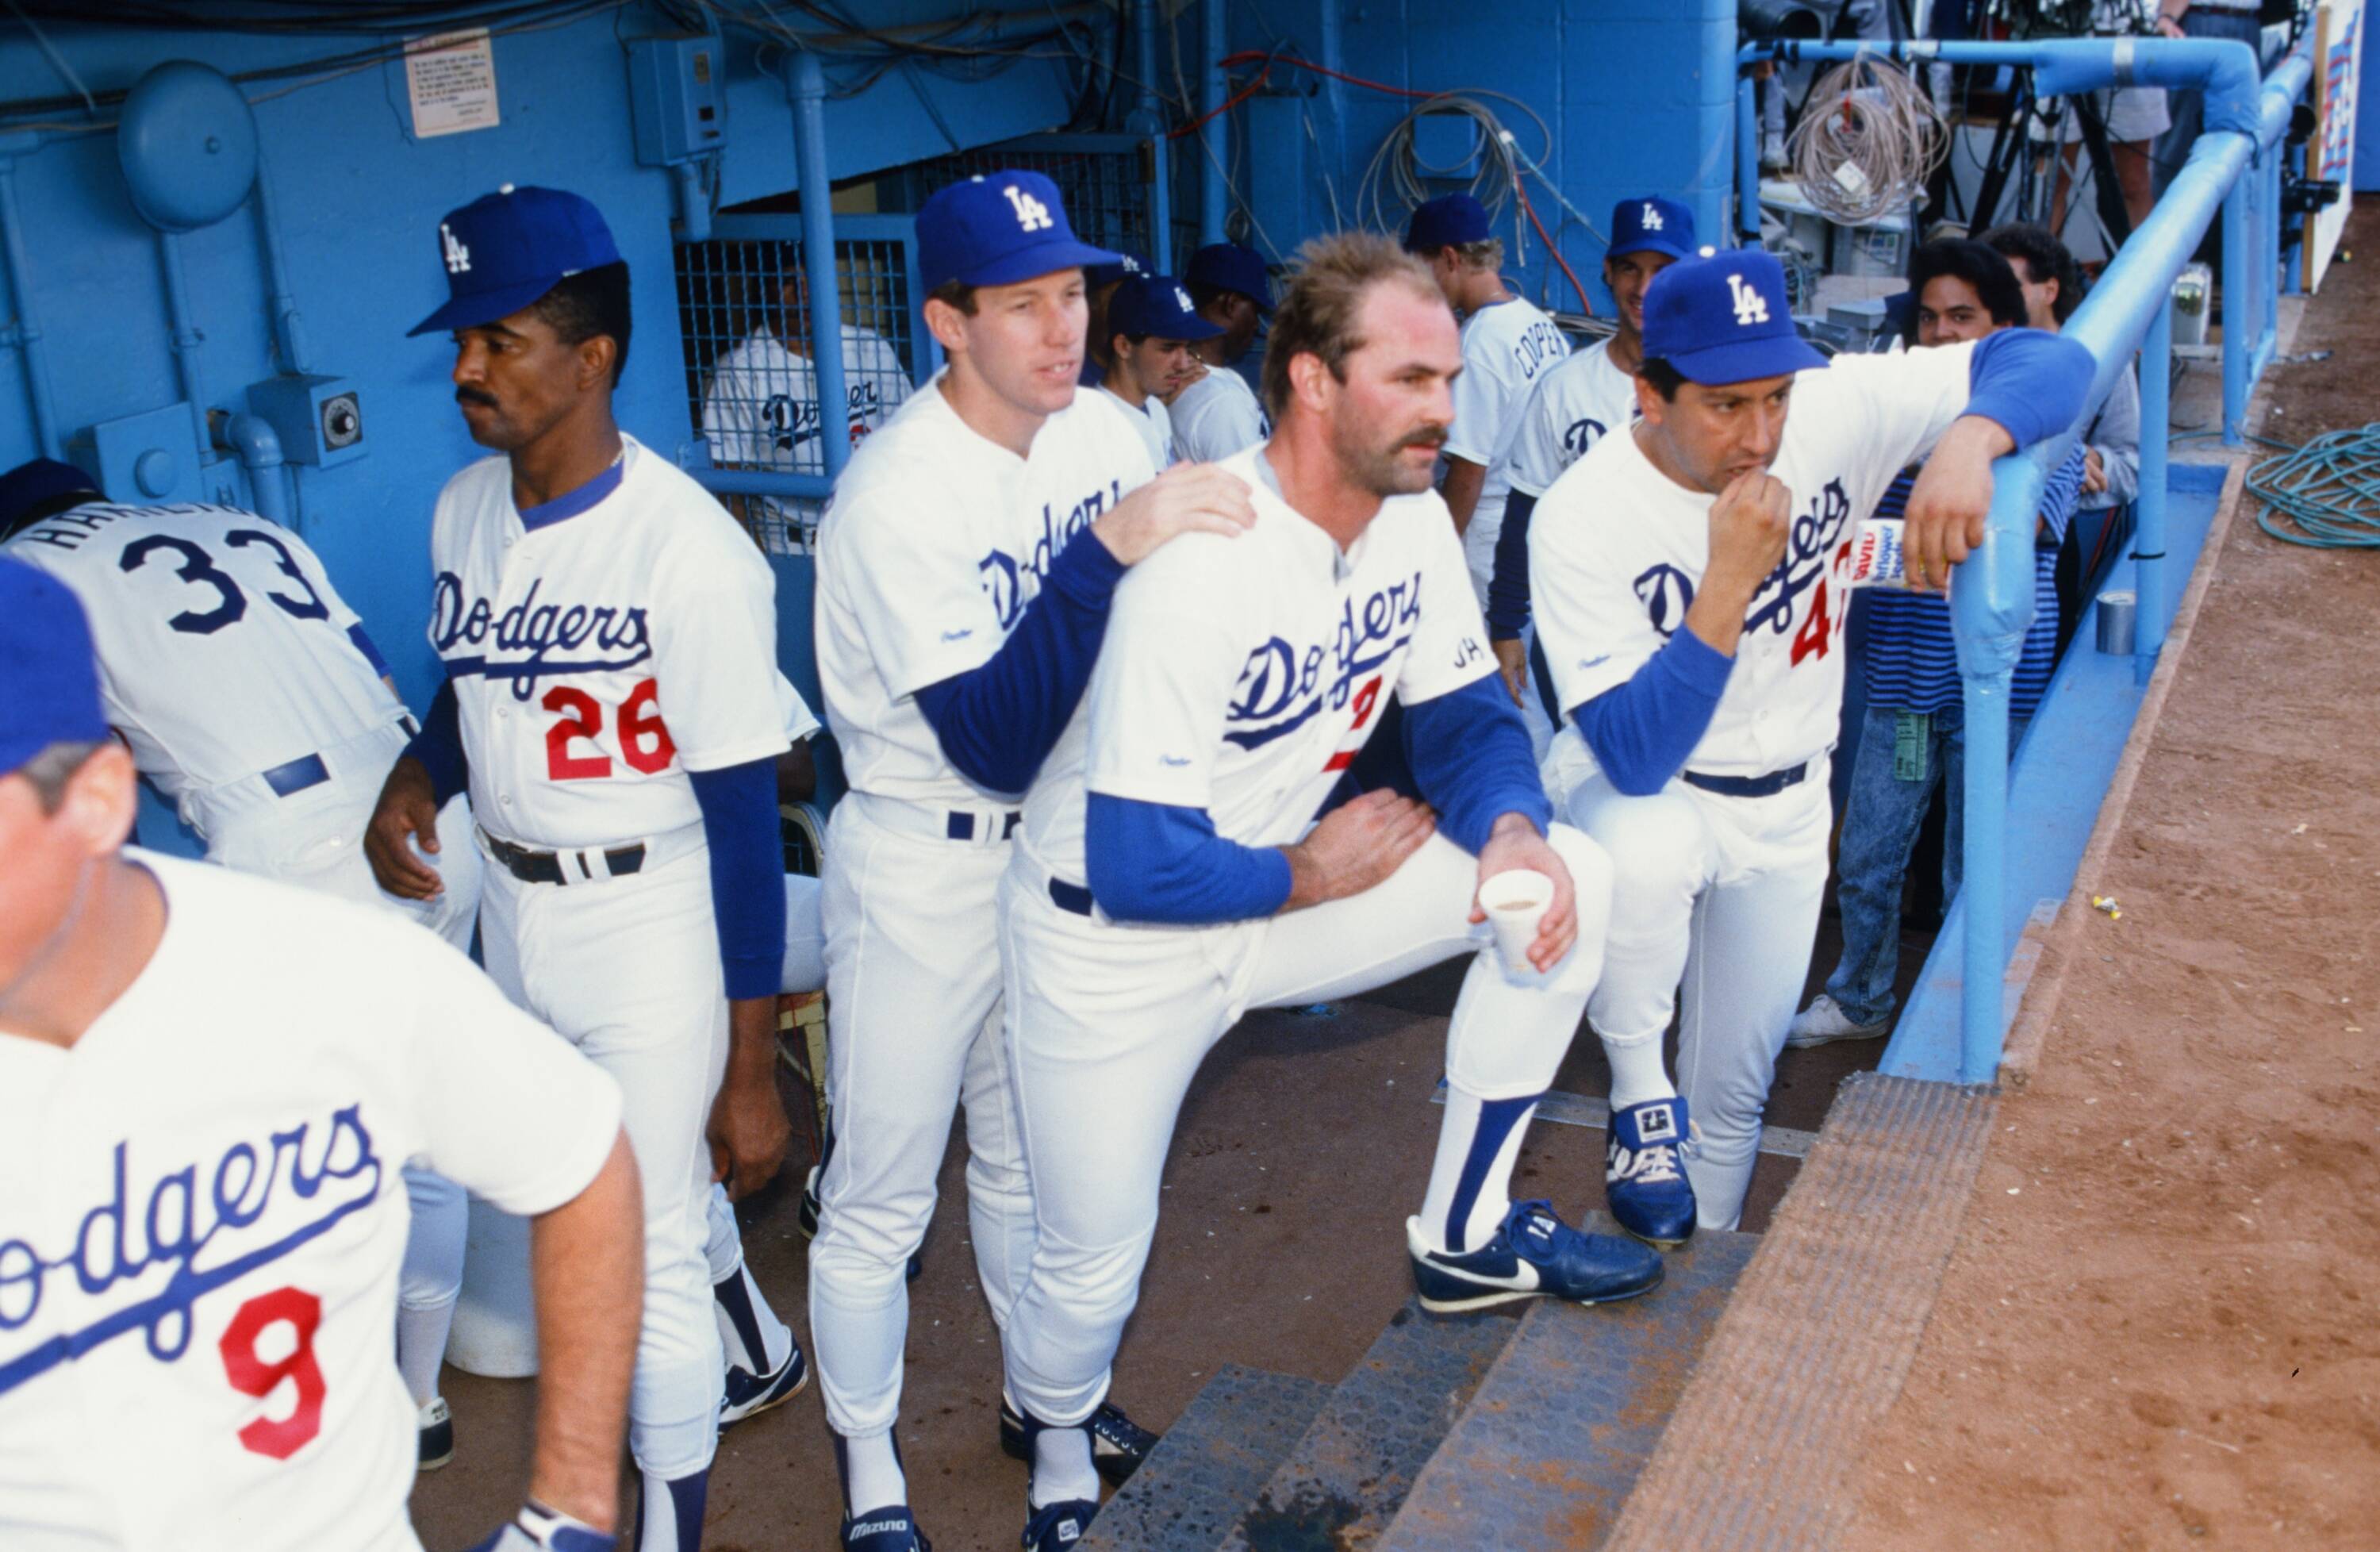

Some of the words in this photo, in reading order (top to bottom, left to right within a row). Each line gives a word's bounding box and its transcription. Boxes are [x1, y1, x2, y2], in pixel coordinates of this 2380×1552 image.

[440, 224, 472, 274] LA
[1003, 185, 1054, 232] LA
[1641, 203, 1664, 231] LA
[1726, 274, 1770, 325] LA
[119, 533, 330, 636] 33
[433, 570, 653, 702] Dodgers
[541, 677, 677, 781] 26
[0, 1101, 382, 1362] odgers
[217, 1285, 327, 1462] 9
